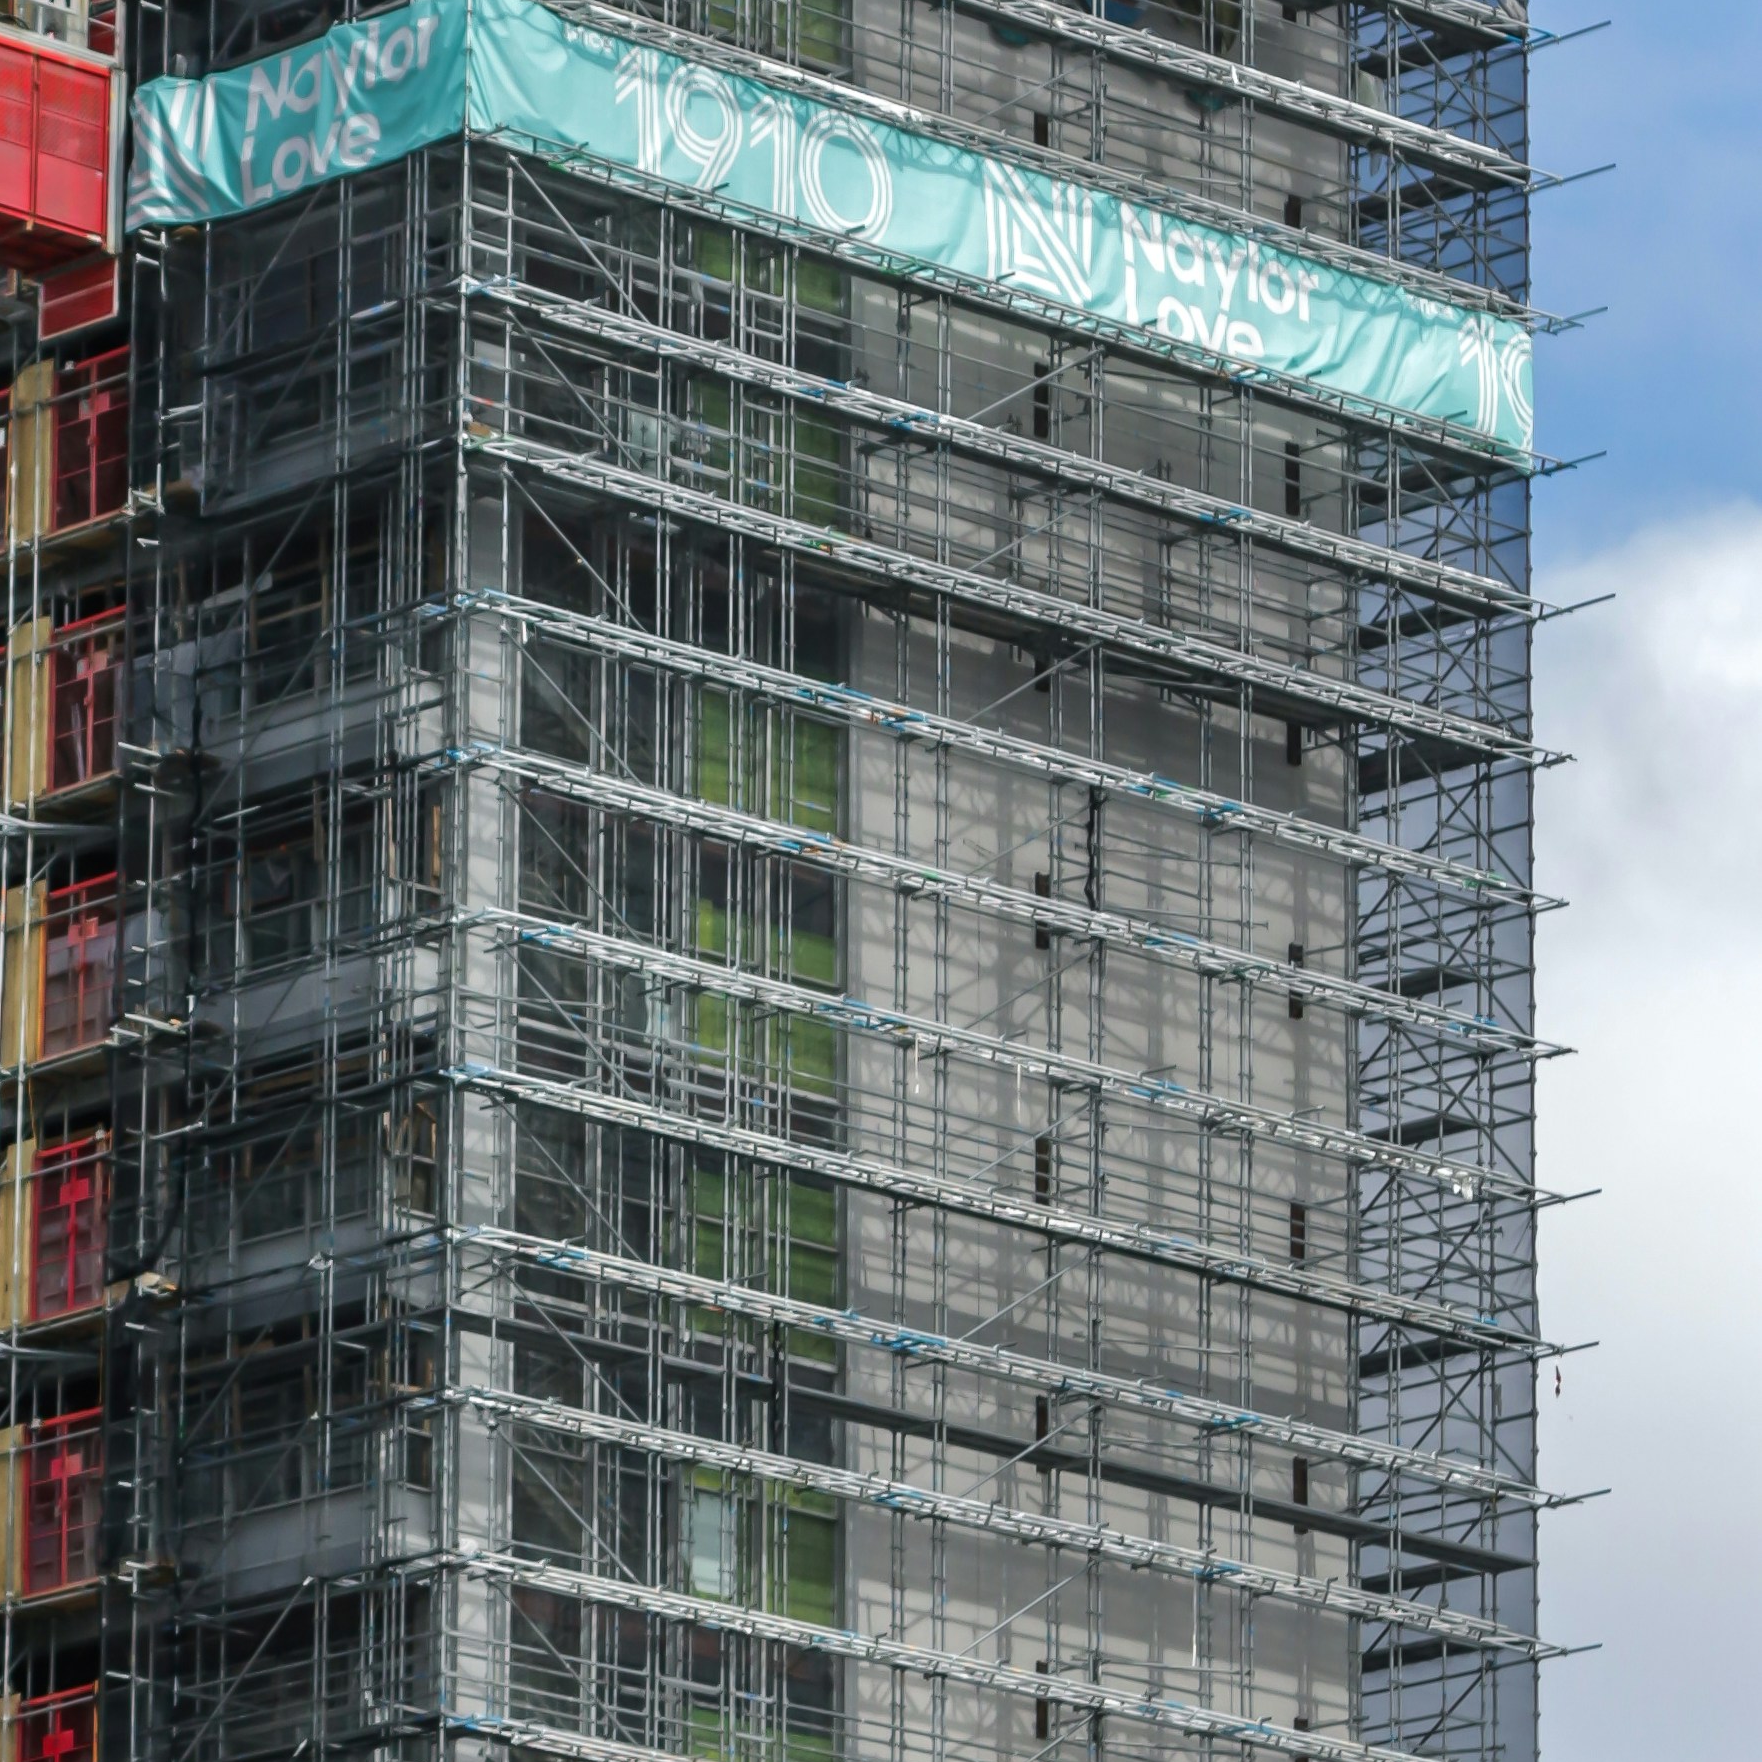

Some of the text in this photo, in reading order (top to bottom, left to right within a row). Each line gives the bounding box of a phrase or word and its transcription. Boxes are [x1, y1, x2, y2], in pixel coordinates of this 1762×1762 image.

[245, 15, 439, 132] Naylor
[241, 112, 381, 205] Love
[614, 46, 893, 243] 1910
[1120, 202, 1319, 322] Naylor
[1125, 266, 1265, 358] Love
